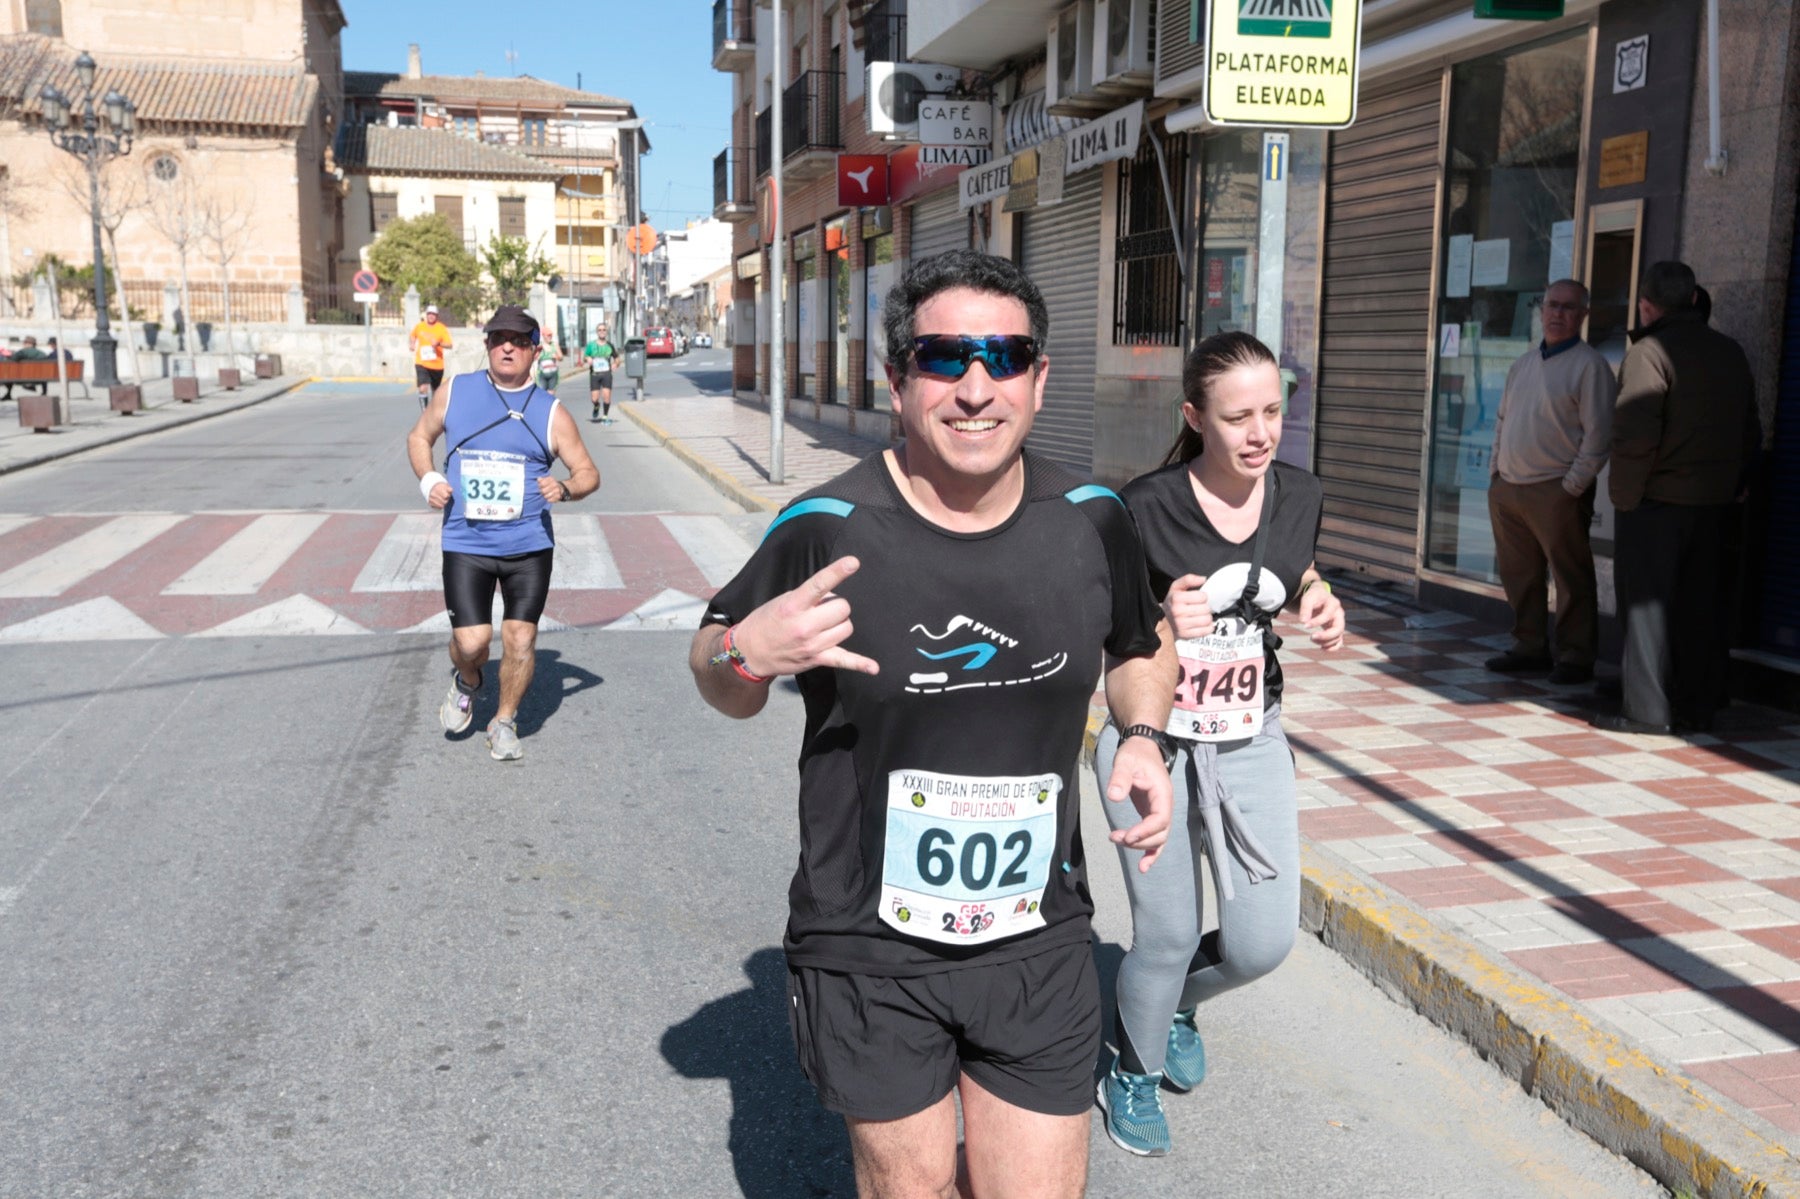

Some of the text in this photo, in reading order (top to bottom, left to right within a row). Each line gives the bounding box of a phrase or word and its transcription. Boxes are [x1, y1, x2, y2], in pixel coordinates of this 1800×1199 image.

[1216, 52, 1349, 75] PLATAFORMA
[1236, 85, 1326, 107] ELEVADA
[921, 105, 972, 121] CAFÉ
[953, 126, 989, 141] BAR
[1070, 129, 1109, 164] LIMA
[468, 479, 510, 500] 332
[902, 773, 934, 793] XXXIII
[936, 780, 968, 798] GRAN
[971, 782, 1010, 799] PREMIO
[1013, 783, 1026, 798] DE
[950, 800, 1016, 818] DIPUTACIÓN
[916, 827, 1032, 891] 602
